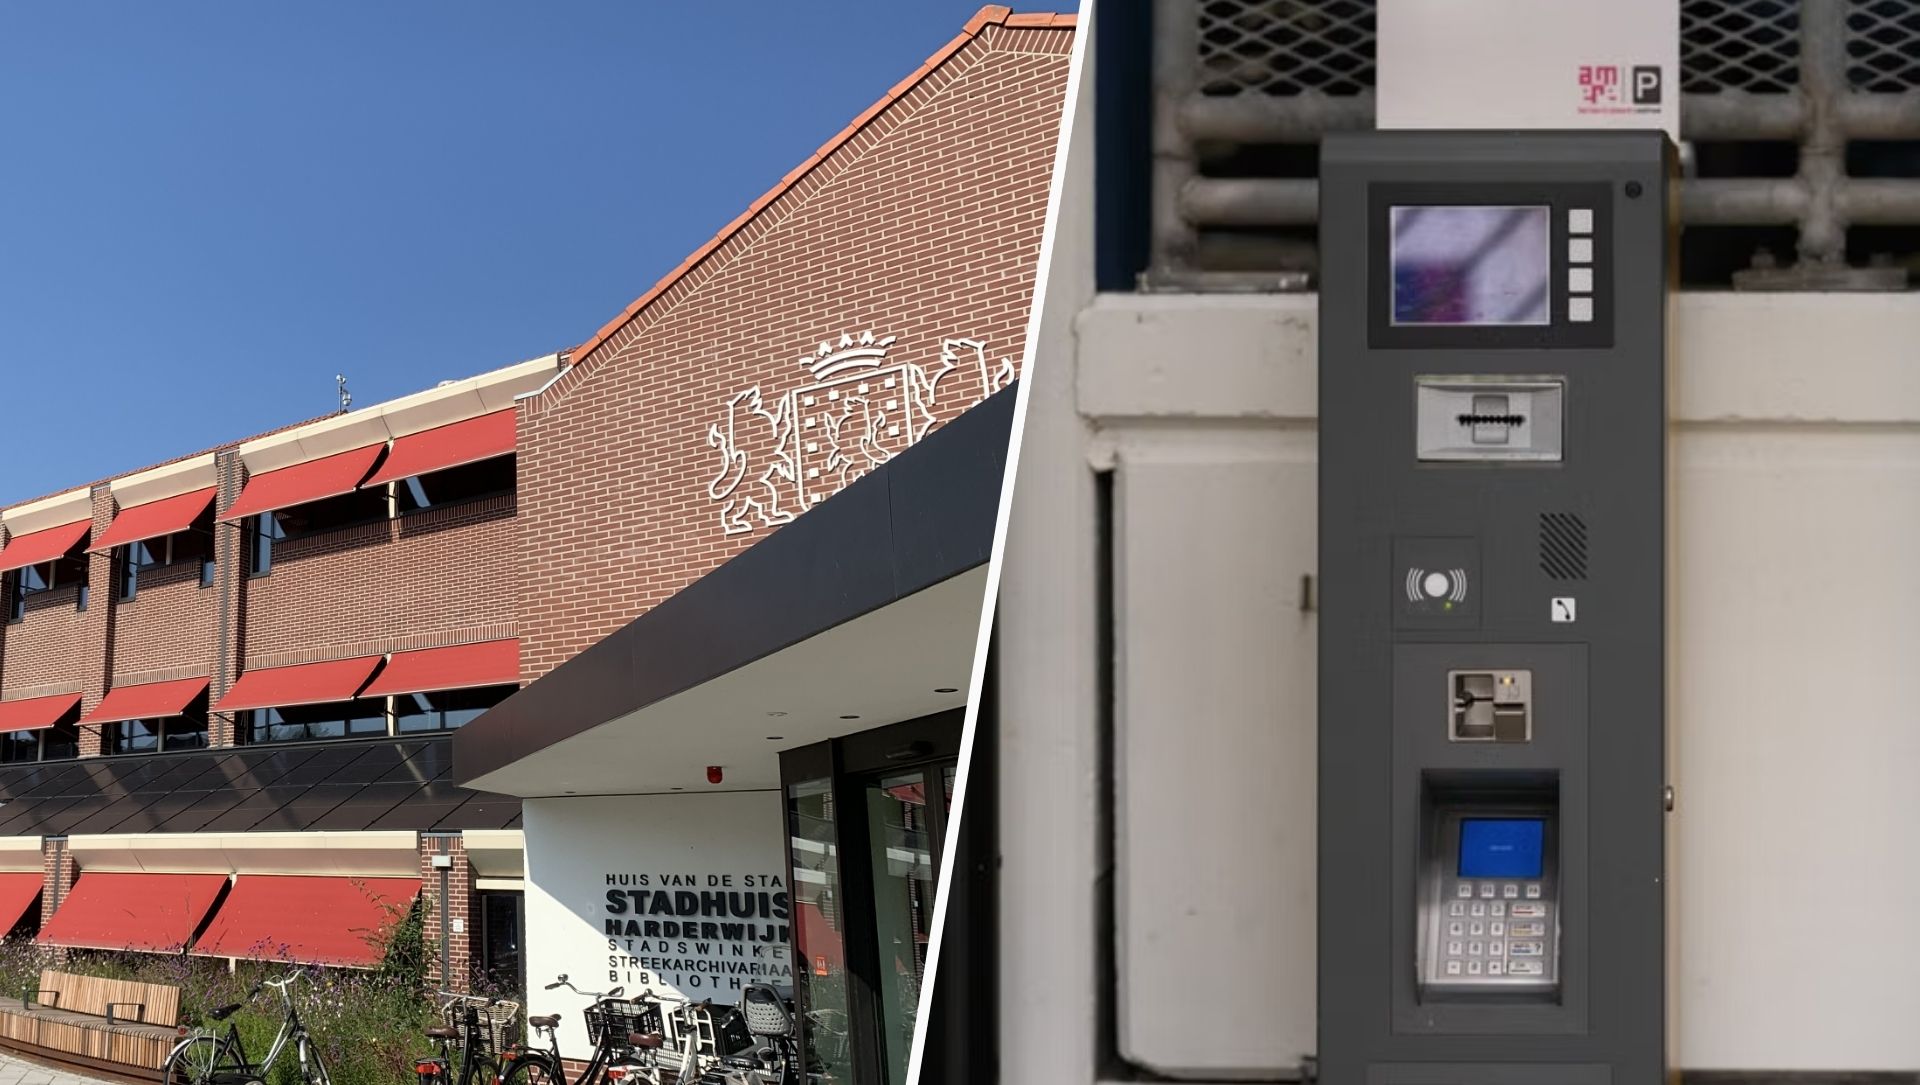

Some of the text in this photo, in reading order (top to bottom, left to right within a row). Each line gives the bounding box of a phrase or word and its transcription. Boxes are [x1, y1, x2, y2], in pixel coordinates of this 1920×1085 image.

[606, 873, 788, 888] HUIS VAN DE STA
[605, 889, 789, 920] STADHUIS
[605, 918, 789, 942] HARDERWIJK
